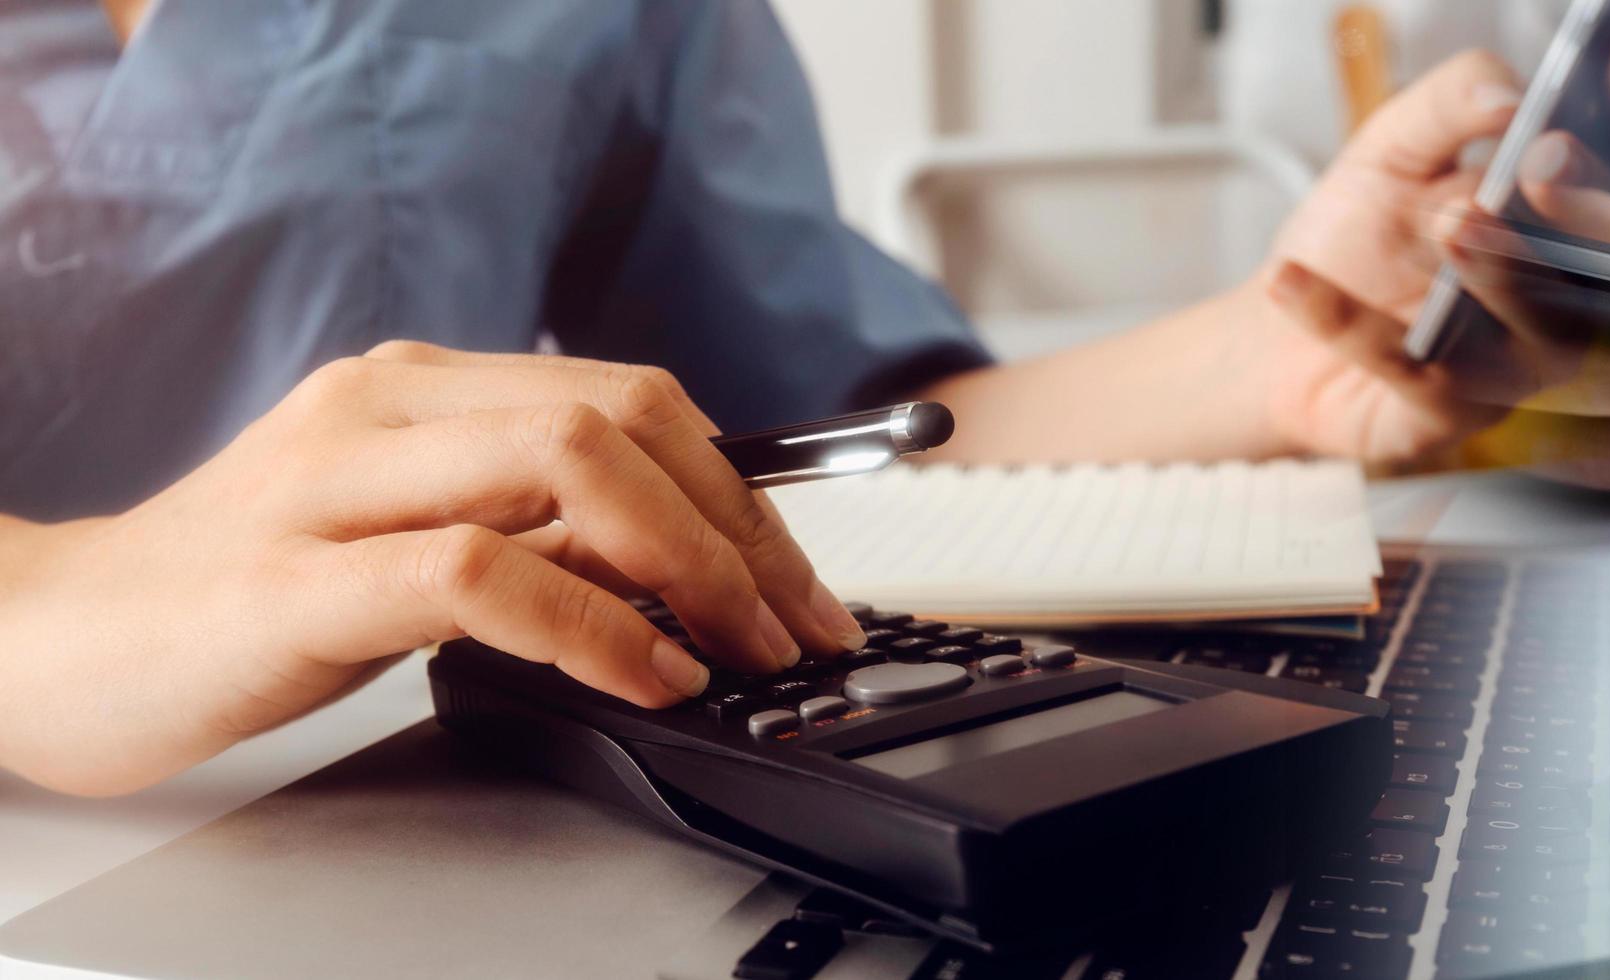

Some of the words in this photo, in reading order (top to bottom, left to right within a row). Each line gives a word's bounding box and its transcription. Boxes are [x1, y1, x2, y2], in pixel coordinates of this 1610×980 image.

[777, 731, 799, 740] ON
[1495, 781, 1524, 790] 9
[1488, 821, 1520, 829] 0
